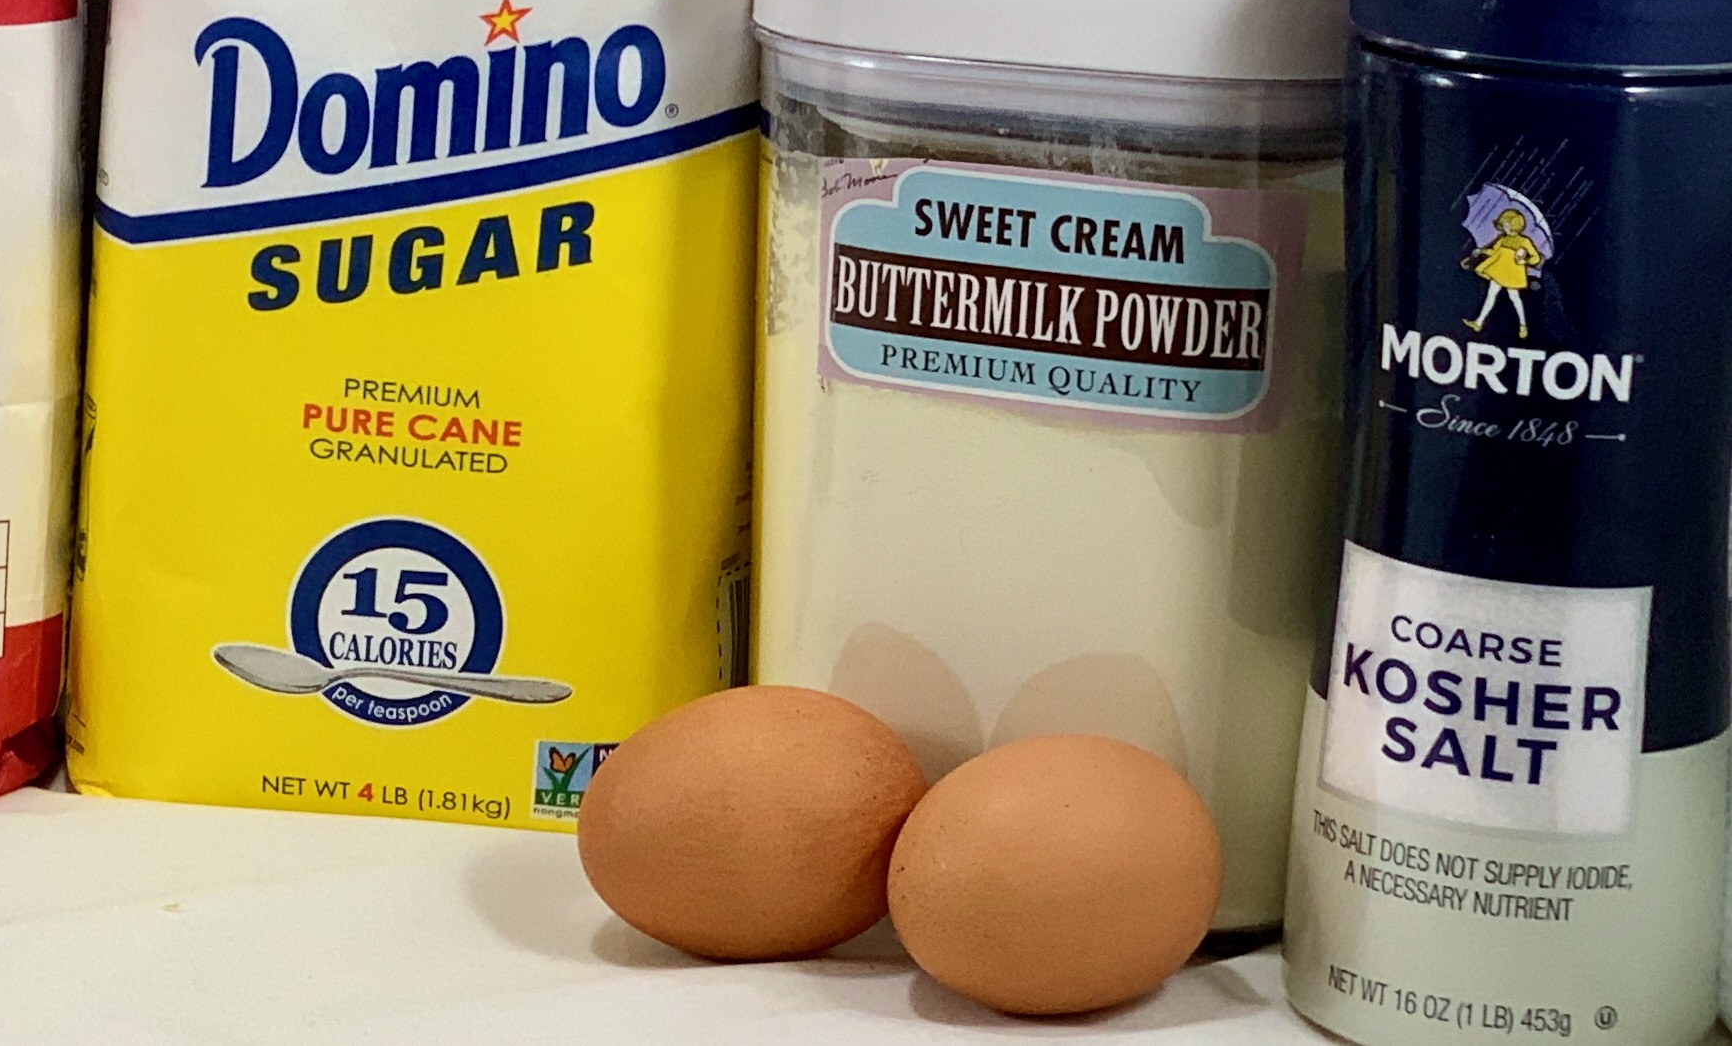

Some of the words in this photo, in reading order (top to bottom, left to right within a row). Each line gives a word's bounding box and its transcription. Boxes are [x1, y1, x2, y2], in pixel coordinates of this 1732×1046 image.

[194, 9, 667, 189] Domino
[247, 201, 596, 312] SUGAR
[914, 198, 1037, 248] SWEET
[1050, 215, 1185, 265] CREAM
[834, 255, 1084, 345] BUTTERMILK
[1093, 289, 1264, 360] POWDER
[344, 378, 481, 409] PREMIUM
[881, 344, 1036, 385] PREMIUM
[1047, 366, 1202, 402] QUALITY
[1381, 323, 1634, 404] MORTON
[302, 403, 395, 438] PURE
[407, 414, 523, 447] CANE
[1416, 394, 1502, 439] Since
[1507, 418, 1579, 447] 1848
[309, 438, 508, 475] GRANULATED
[340, 567, 449, 635] 15
[329, 631, 458, 670] CALORIES
[1390, 614, 1563, 667] COARSE
[331, 685, 364, 713] per
[367, 693, 452, 723] teaspoon
[1343, 643, 1622, 731] KOSHER
[1381, 717, 1558, 786] SALT
[261, 775, 306, 796] NET
[314, 780, 351, 800] WT
[357, 782, 374, 802] 4
[382, 785, 408, 805] LB
[418, 788, 512, 821] (1.81kg)
[1313, 810, 1337, 842] THIS
[1339, 824, 1378, 858] SALT
[1379, 837, 1431, 872] DOES
[1435, 852, 1480, 880] NOT
[1483, 861, 1562, 890] SUPPLY
[1566, 864, 1633, 891] IODIDE,
[1328, 965, 1358, 996] NET
[1360, 976, 1389, 1005] WT
[1394, 989, 1417, 1013] 16
[1422, 995, 1451, 1022] OZ
[1481, 1003, 1514, 1033] LB)
[1520, 1009, 1572, 1037] 453g
